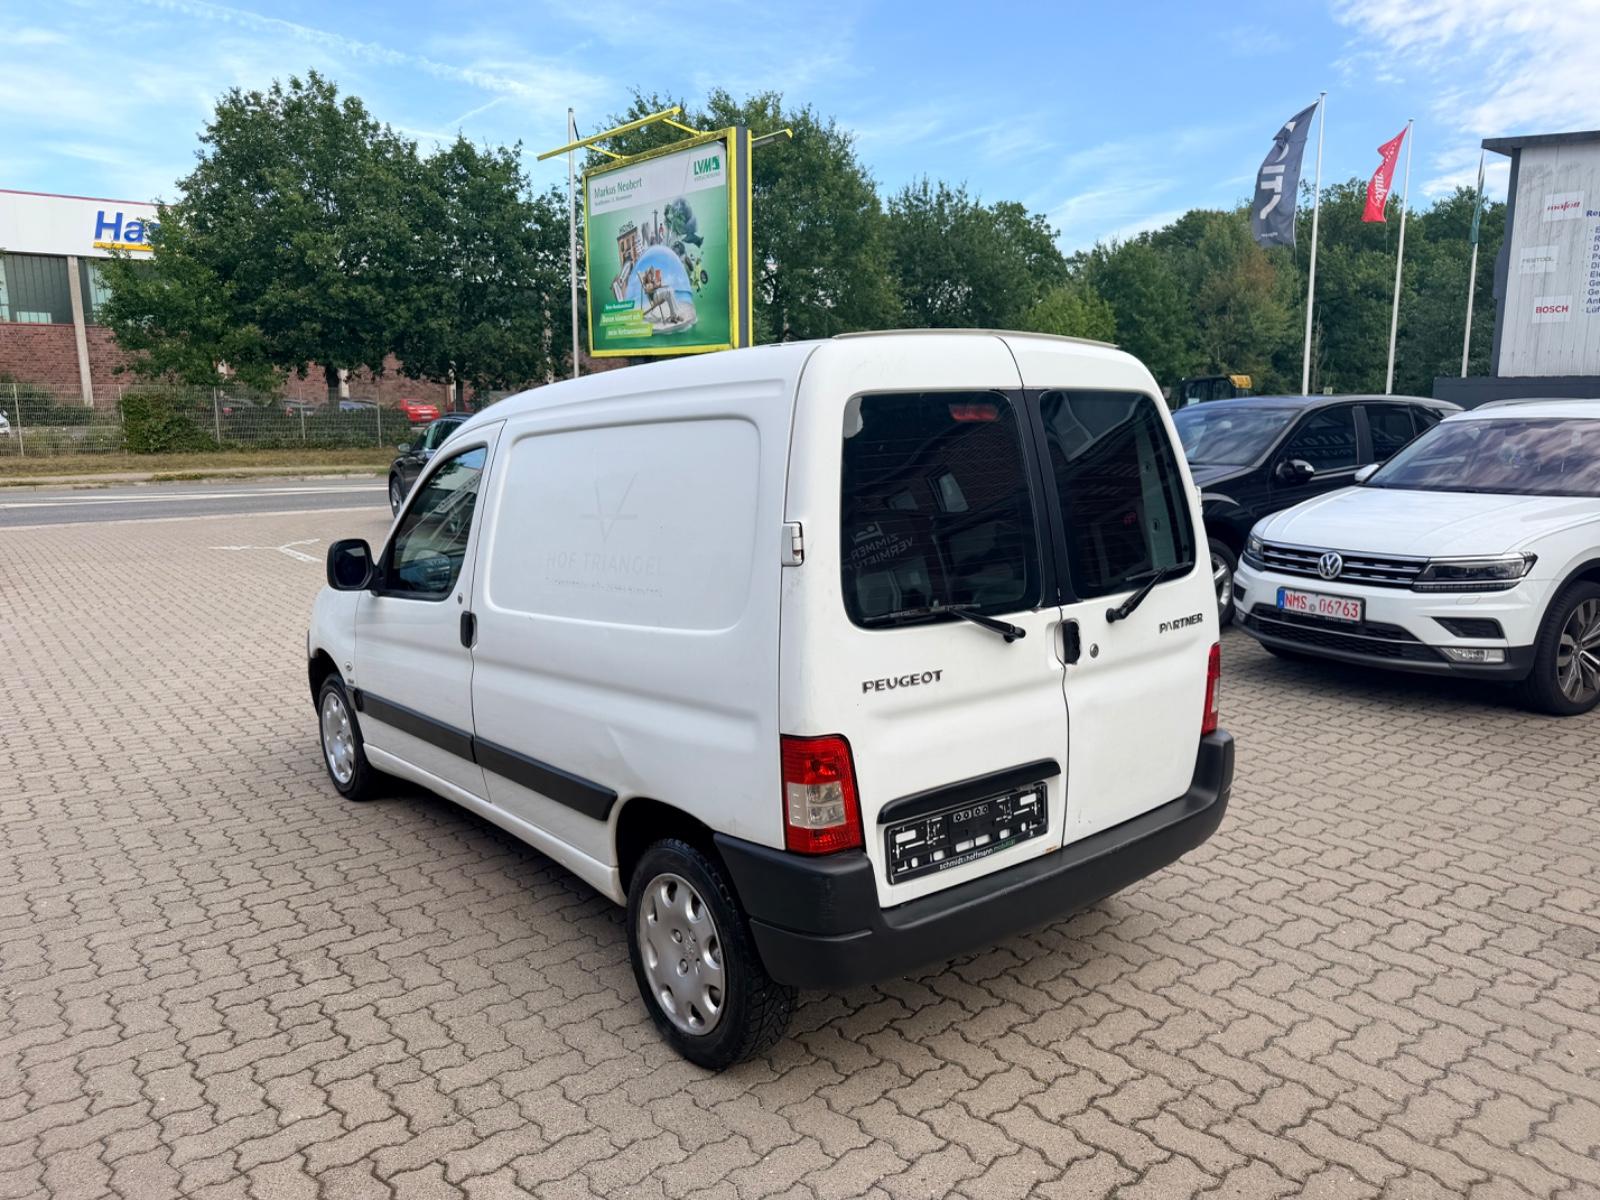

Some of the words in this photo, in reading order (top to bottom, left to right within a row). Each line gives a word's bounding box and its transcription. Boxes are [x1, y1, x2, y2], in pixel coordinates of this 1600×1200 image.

[694, 157, 712, 175] LVM
[594, 186, 616, 199] Markus
[1535, 305, 1569, 314] BOSCH
[546, 551, 577, 568] HOF
[1285, 593, 1307, 610] NMS
[1319, 598, 1358, 618] 06763
[1159, 612, 1204, 634] PARTNER
[862, 669, 944, 694] PEUGEOT
